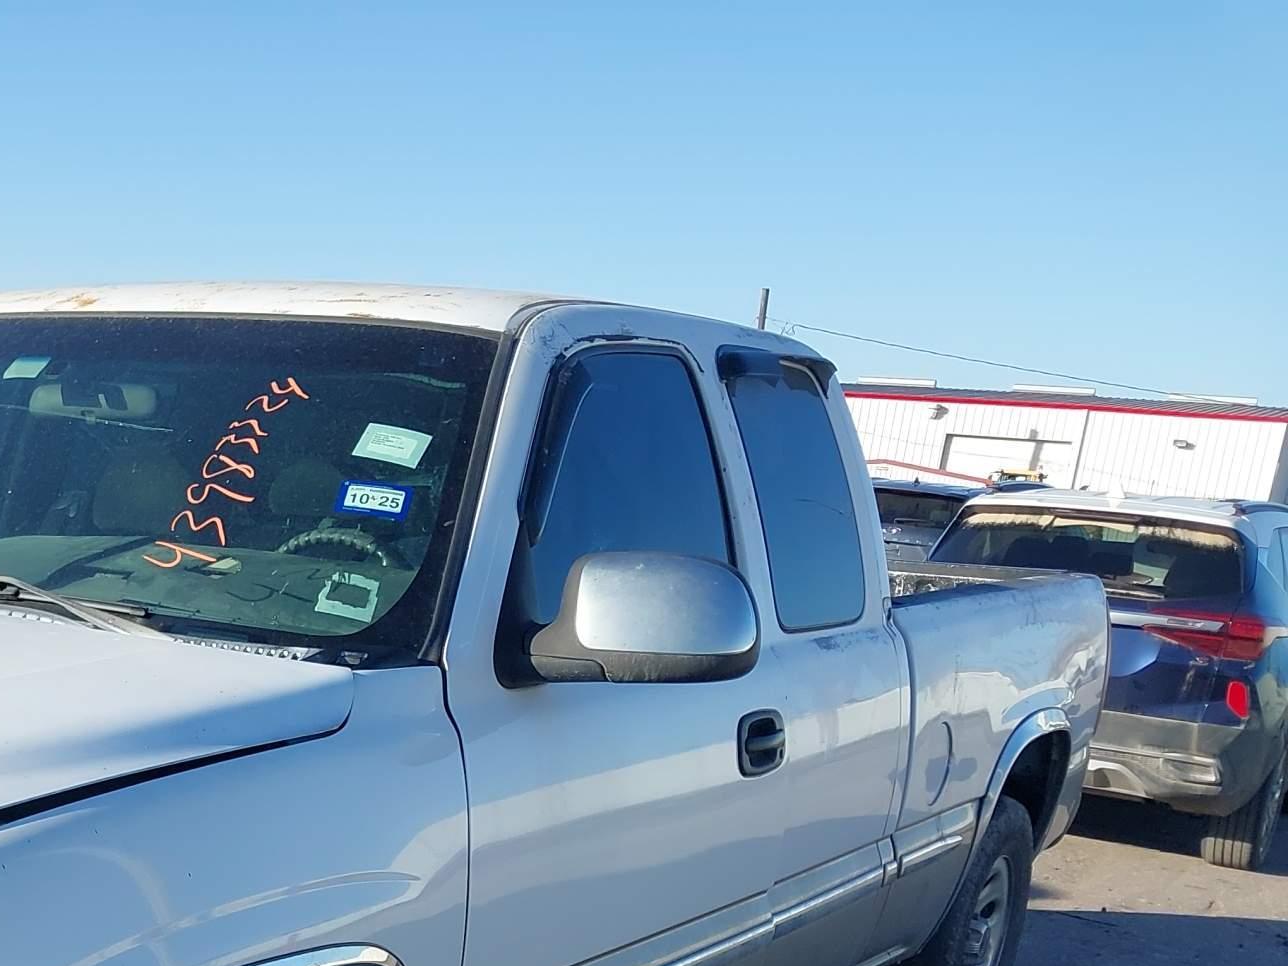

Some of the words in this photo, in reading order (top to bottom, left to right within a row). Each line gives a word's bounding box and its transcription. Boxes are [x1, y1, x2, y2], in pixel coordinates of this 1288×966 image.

[142, 377, 309, 568] 43983324
[350, 493, 370, 505] 10
[378, 495, 401, 509] 25
